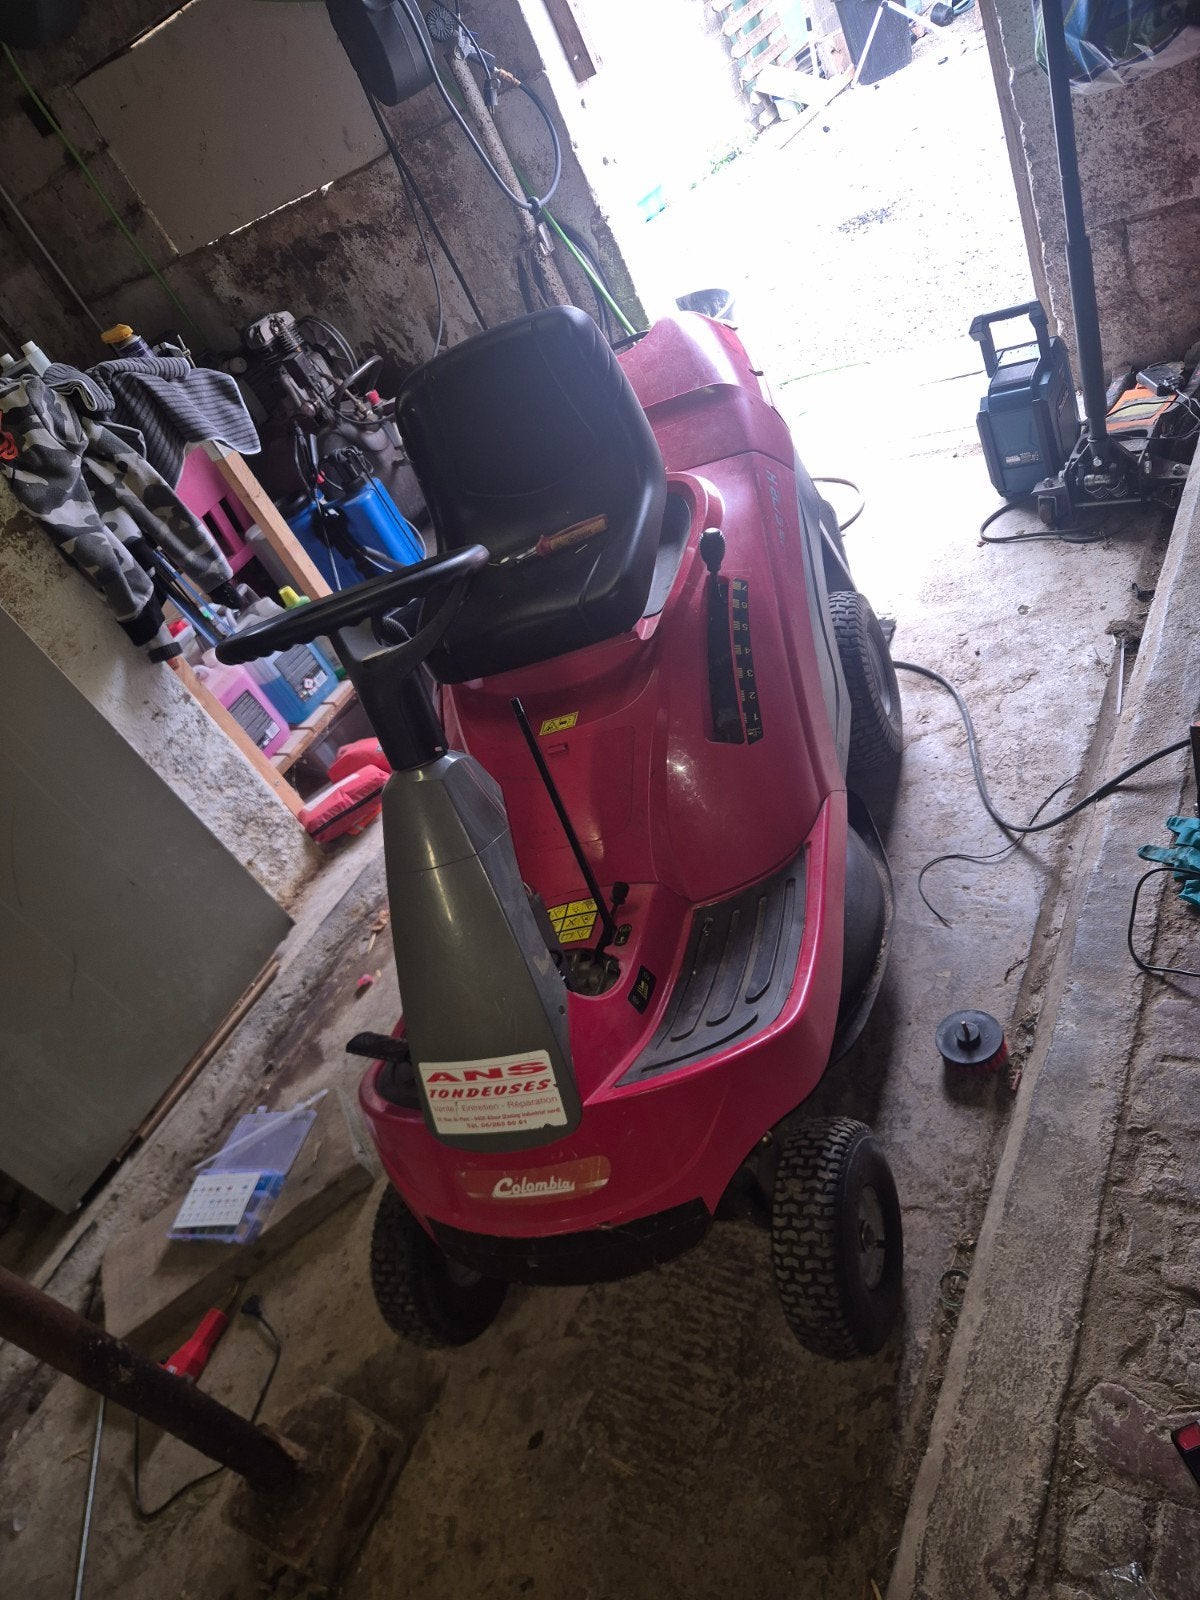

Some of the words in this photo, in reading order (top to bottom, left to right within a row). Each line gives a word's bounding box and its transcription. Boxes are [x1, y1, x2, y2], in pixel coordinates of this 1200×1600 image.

[741, 601, 748, 609] 6
[742, 623, 749, 631] 5
[746, 669, 754, 677] 3
[749, 691, 756, 700] 2
[753, 712, 759, 721] 1
[427, 1061, 548, 1083] ANS
[429, 1079, 551, 1099] TONDEUSES
[493, 1176, 575, 1198] Colombia
